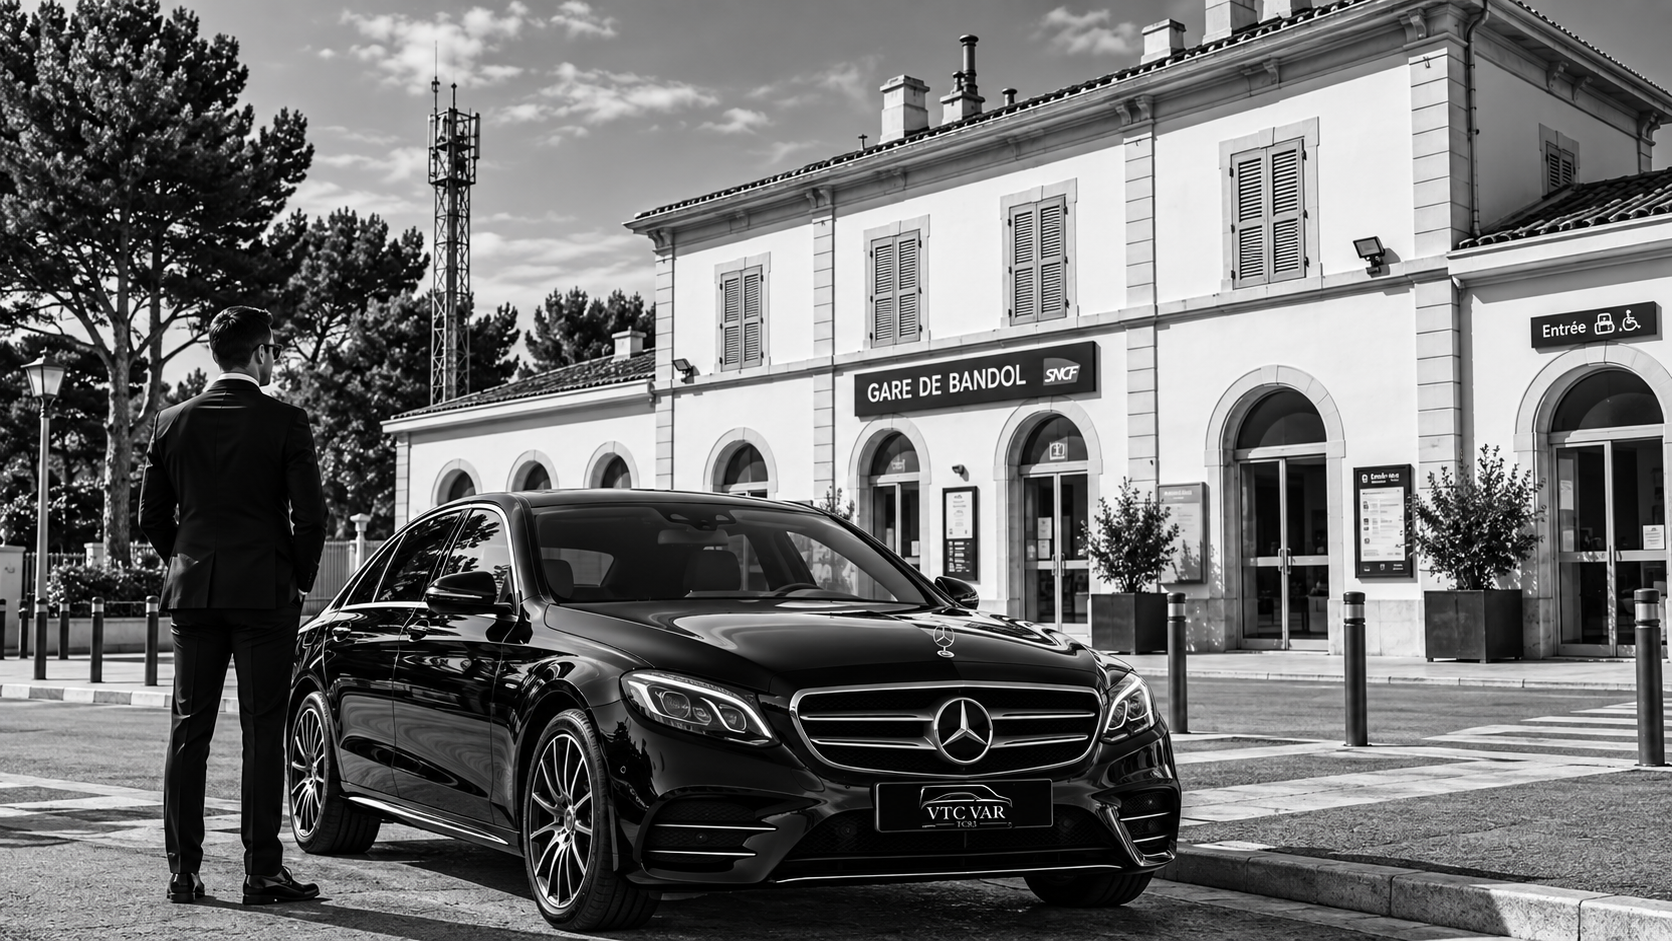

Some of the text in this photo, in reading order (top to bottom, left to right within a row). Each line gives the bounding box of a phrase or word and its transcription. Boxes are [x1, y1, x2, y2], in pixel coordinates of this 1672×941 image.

[1542, 320, 1587, 338] Entrée
[1044, 365, 1080, 383] SNCF
[867, 364, 1027, 403] GARE DE BANDOL
[926, 805, 1006, 820] VTC VAR
